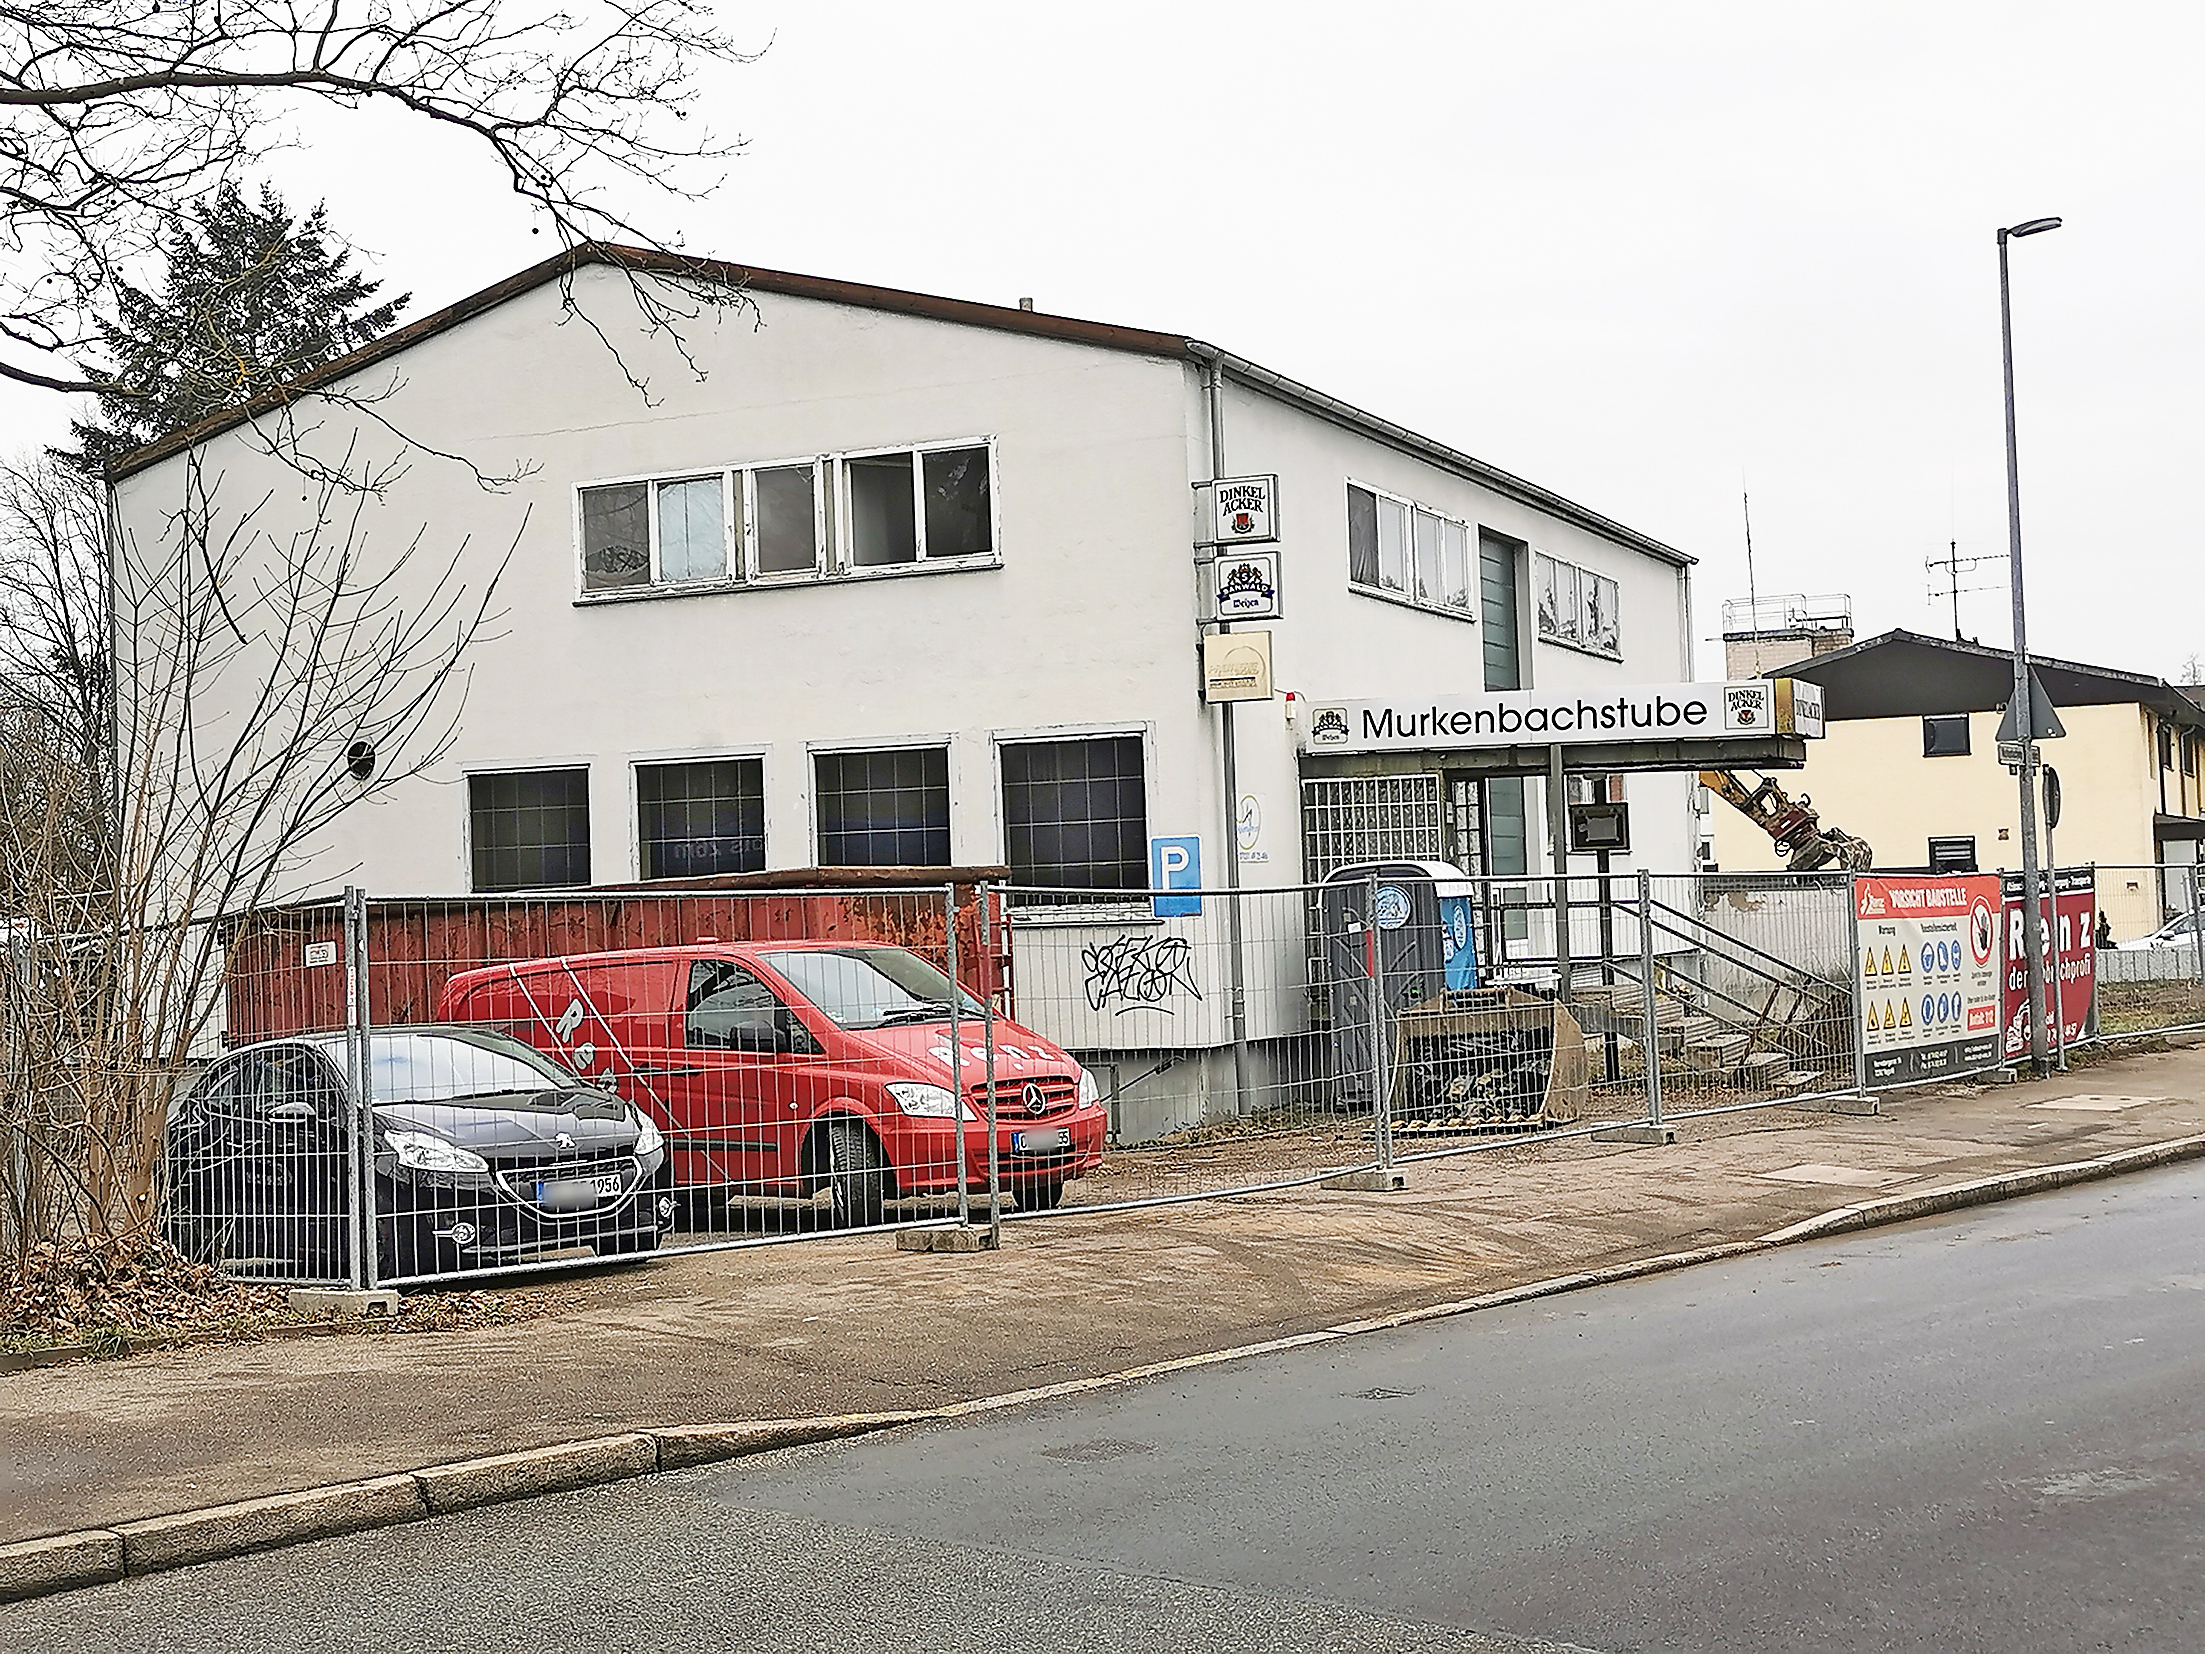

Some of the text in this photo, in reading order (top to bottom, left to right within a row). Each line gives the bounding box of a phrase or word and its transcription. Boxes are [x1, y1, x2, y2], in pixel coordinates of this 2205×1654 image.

[1219, 485, 1266, 504] DINKEL
[1222, 497, 1264, 517] ACKER
[1727, 689, 1765, 704] DINKEL
[1362, 695, 1709, 740] Murkenbachstube
[1160, 844, 1190, 890] P
[2008, 965, 2029, 991] der
